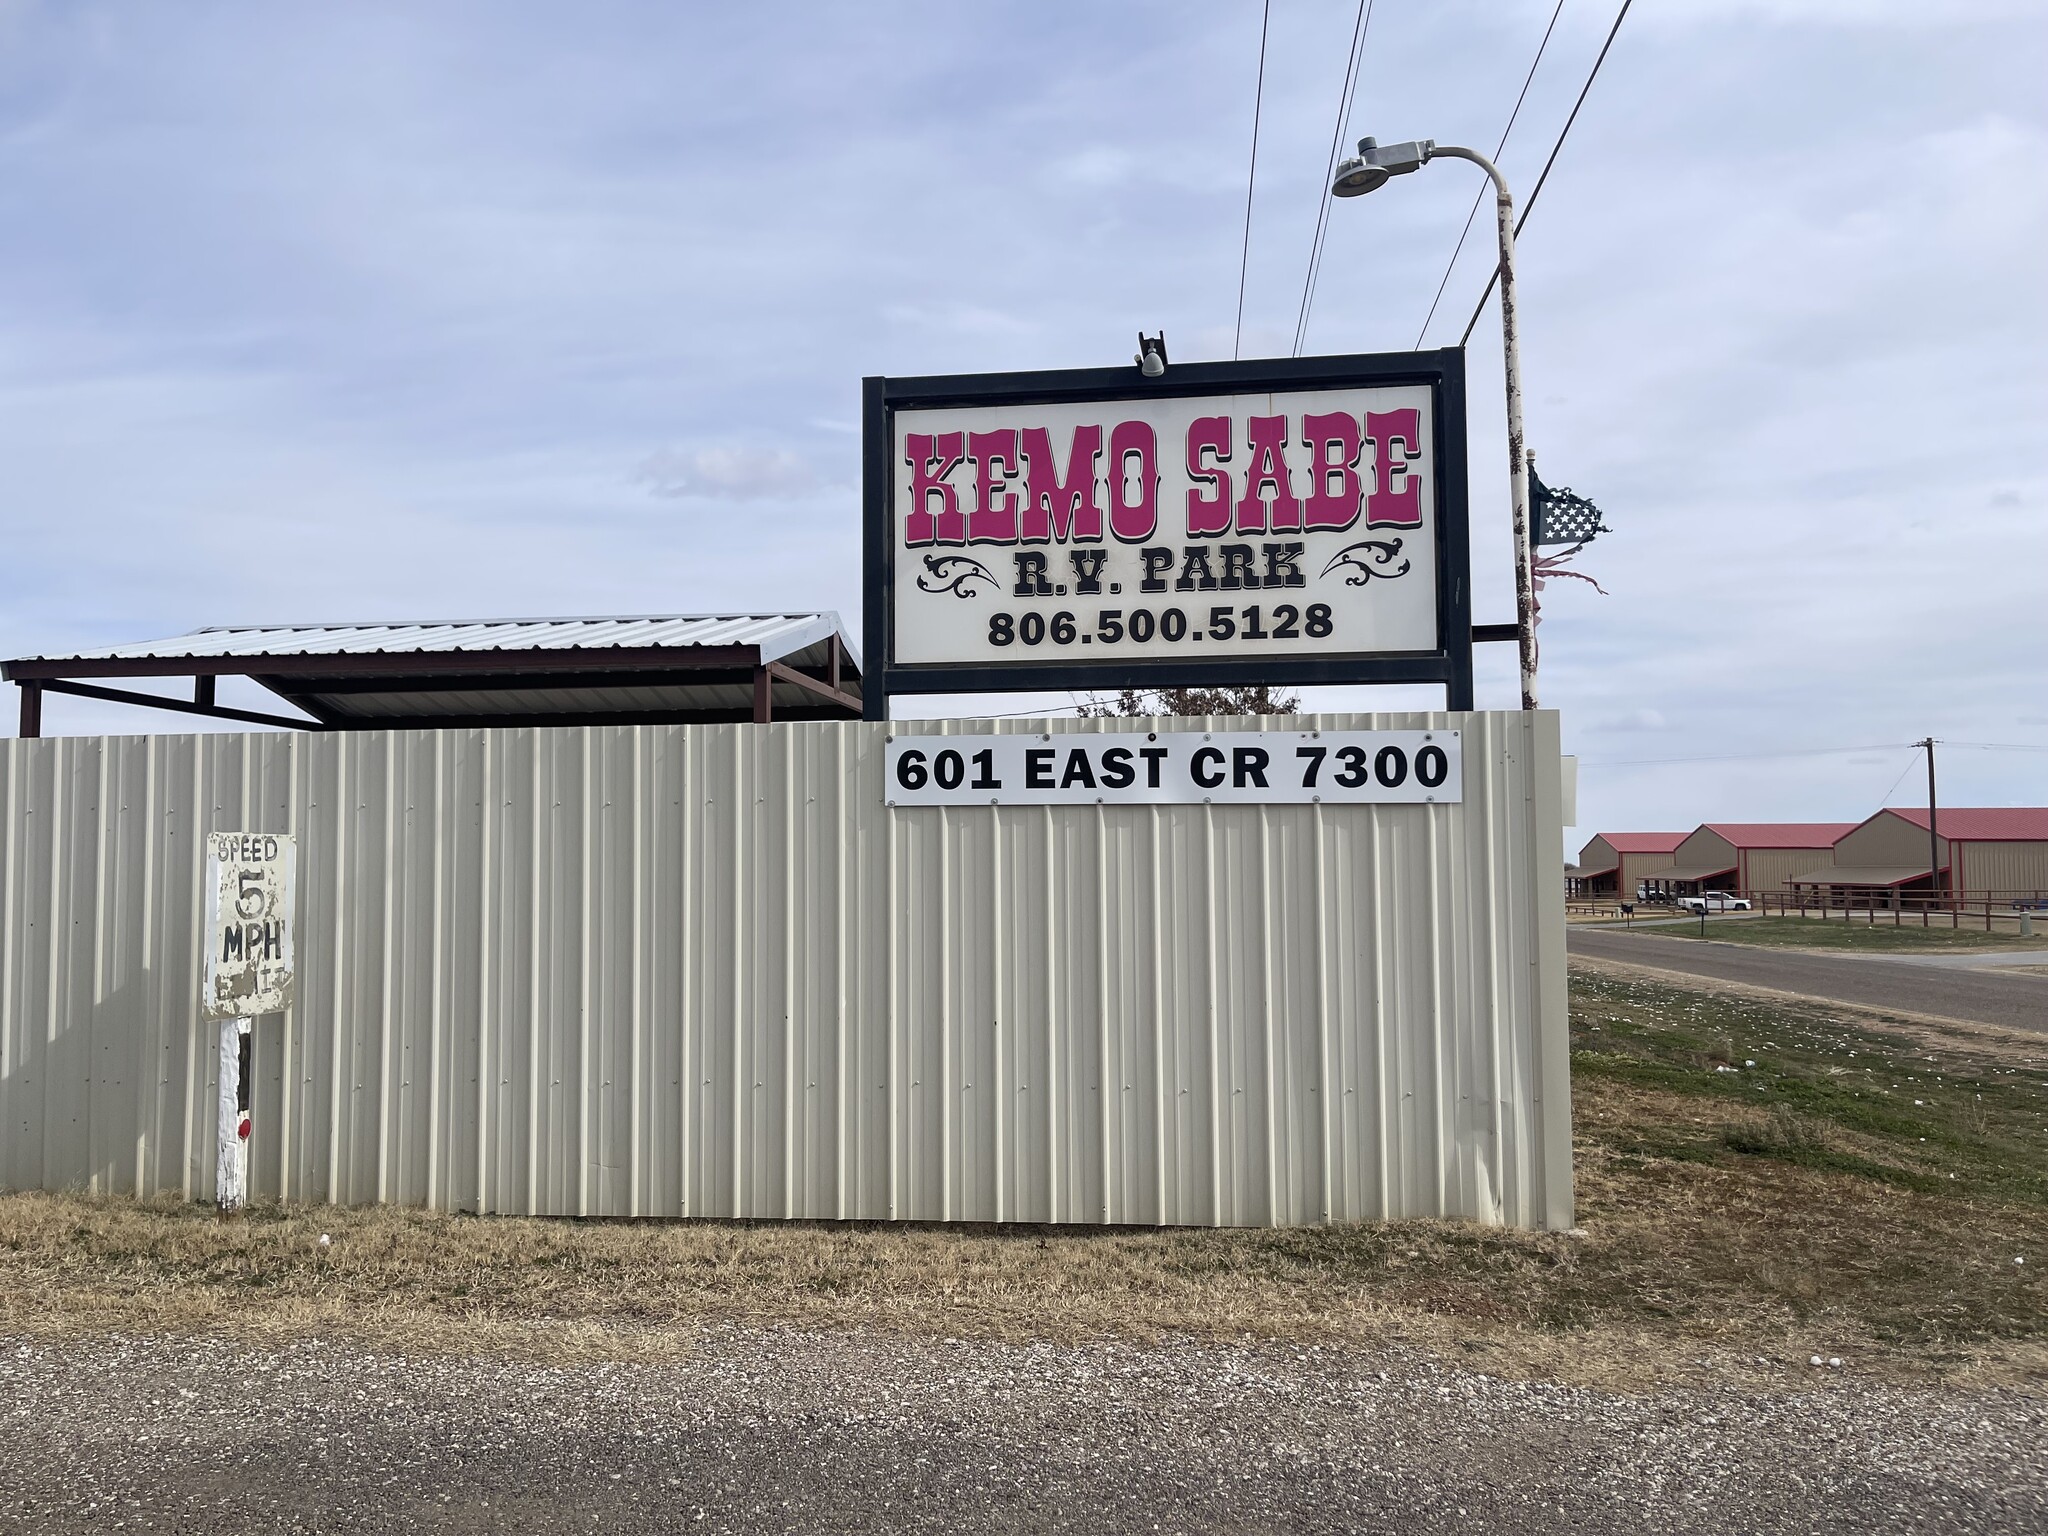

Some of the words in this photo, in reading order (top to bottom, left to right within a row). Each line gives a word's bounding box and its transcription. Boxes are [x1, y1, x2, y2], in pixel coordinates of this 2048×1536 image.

[905, 420, 1160, 547] KEMO
[1185, 408, 1423, 539] SABE
[1012, 548, 1121, 597] R.V.
[1141, 542, 1306, 594] PARK
[988, 603, 1333, 646] 806.500.5128
[897, 749, 1002, 790] 601
[1025, 748, 1168, 788] EAST
[1190, 747, 1270, 788] CR
[1296, 745, 1449, 788] 7300
[217, 835, 278, 863] SPEED
[235, 868, 265, 920] 5
[223, 920, 282, 963] MPH
